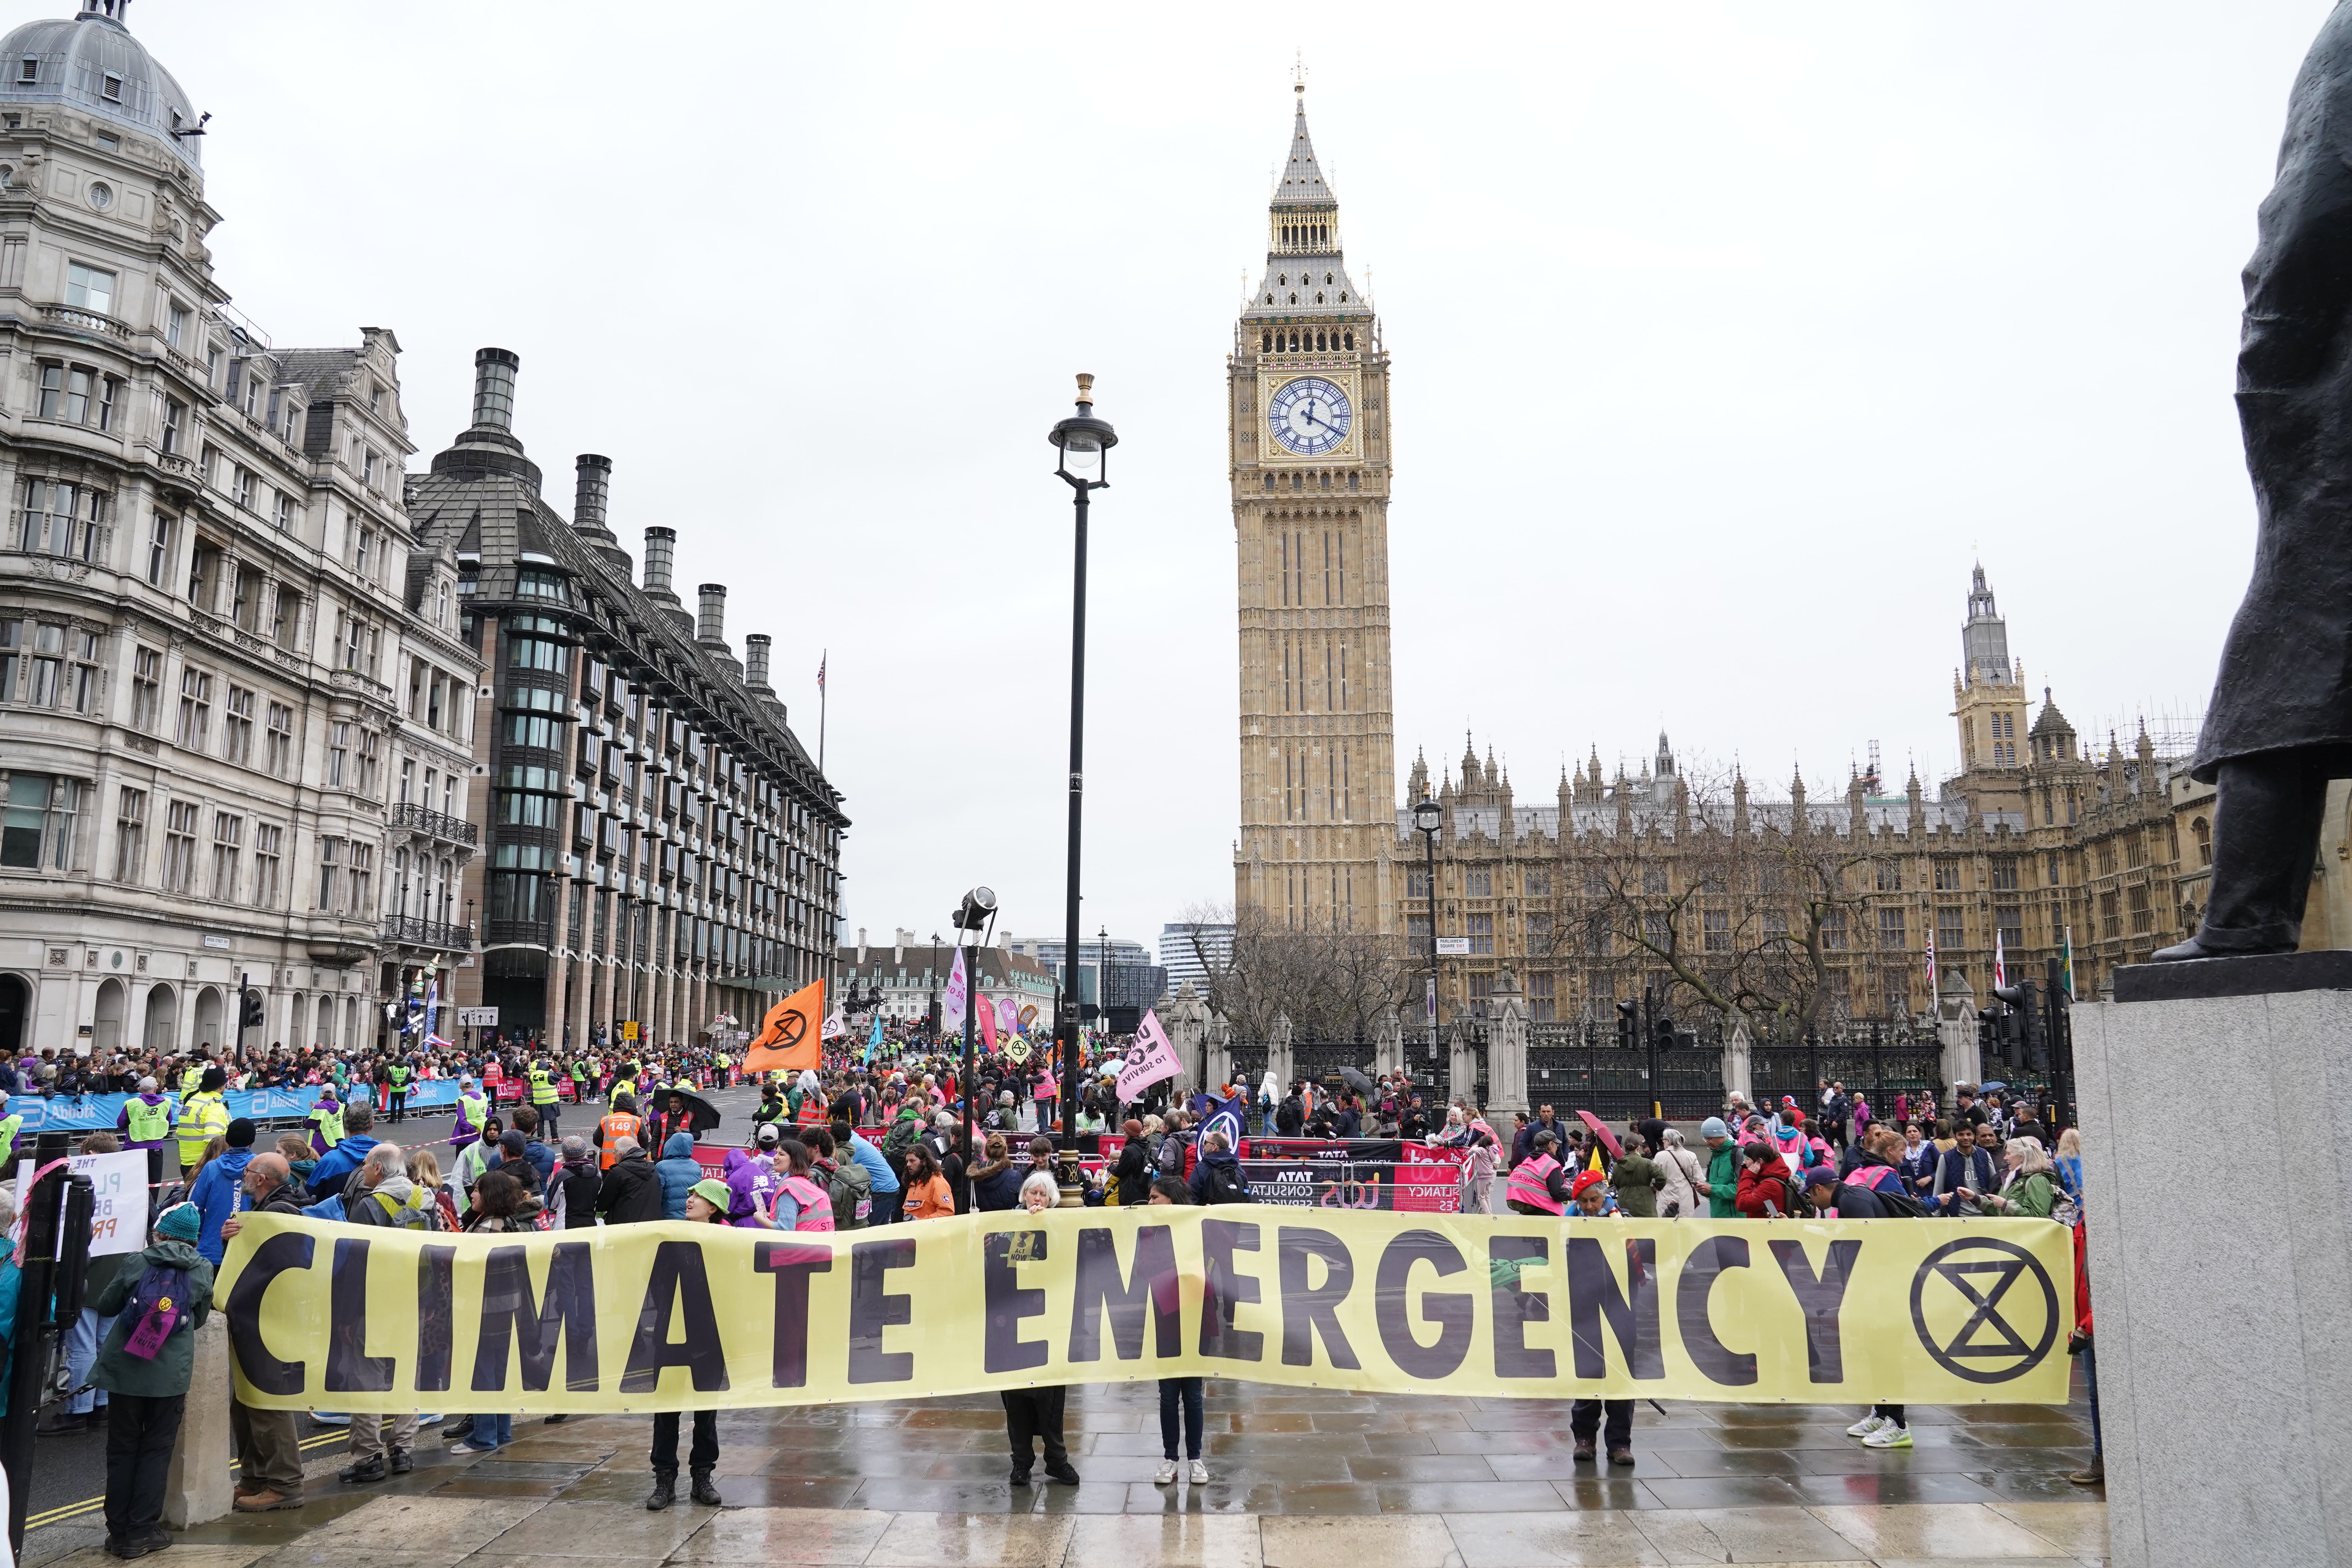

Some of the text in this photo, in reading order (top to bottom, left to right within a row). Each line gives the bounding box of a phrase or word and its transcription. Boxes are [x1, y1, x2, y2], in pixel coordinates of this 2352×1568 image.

[497, 1083, 508, 1096] tcs
[270, 1096, 299, 1108] Abbott
[49, 1103, 95, 1120] Abbott
[610, 1122, 630, 1131] 149
[1510, 1173, 1533, 1183] EWARD
[233, 1187, 241, 1213] TERRE
[984, 1218, 1863, 1386] EMERGENCY
[226, 1232, 916, 1395] CLIMATE
[133, 1336, 156, 1350] TRUTH
